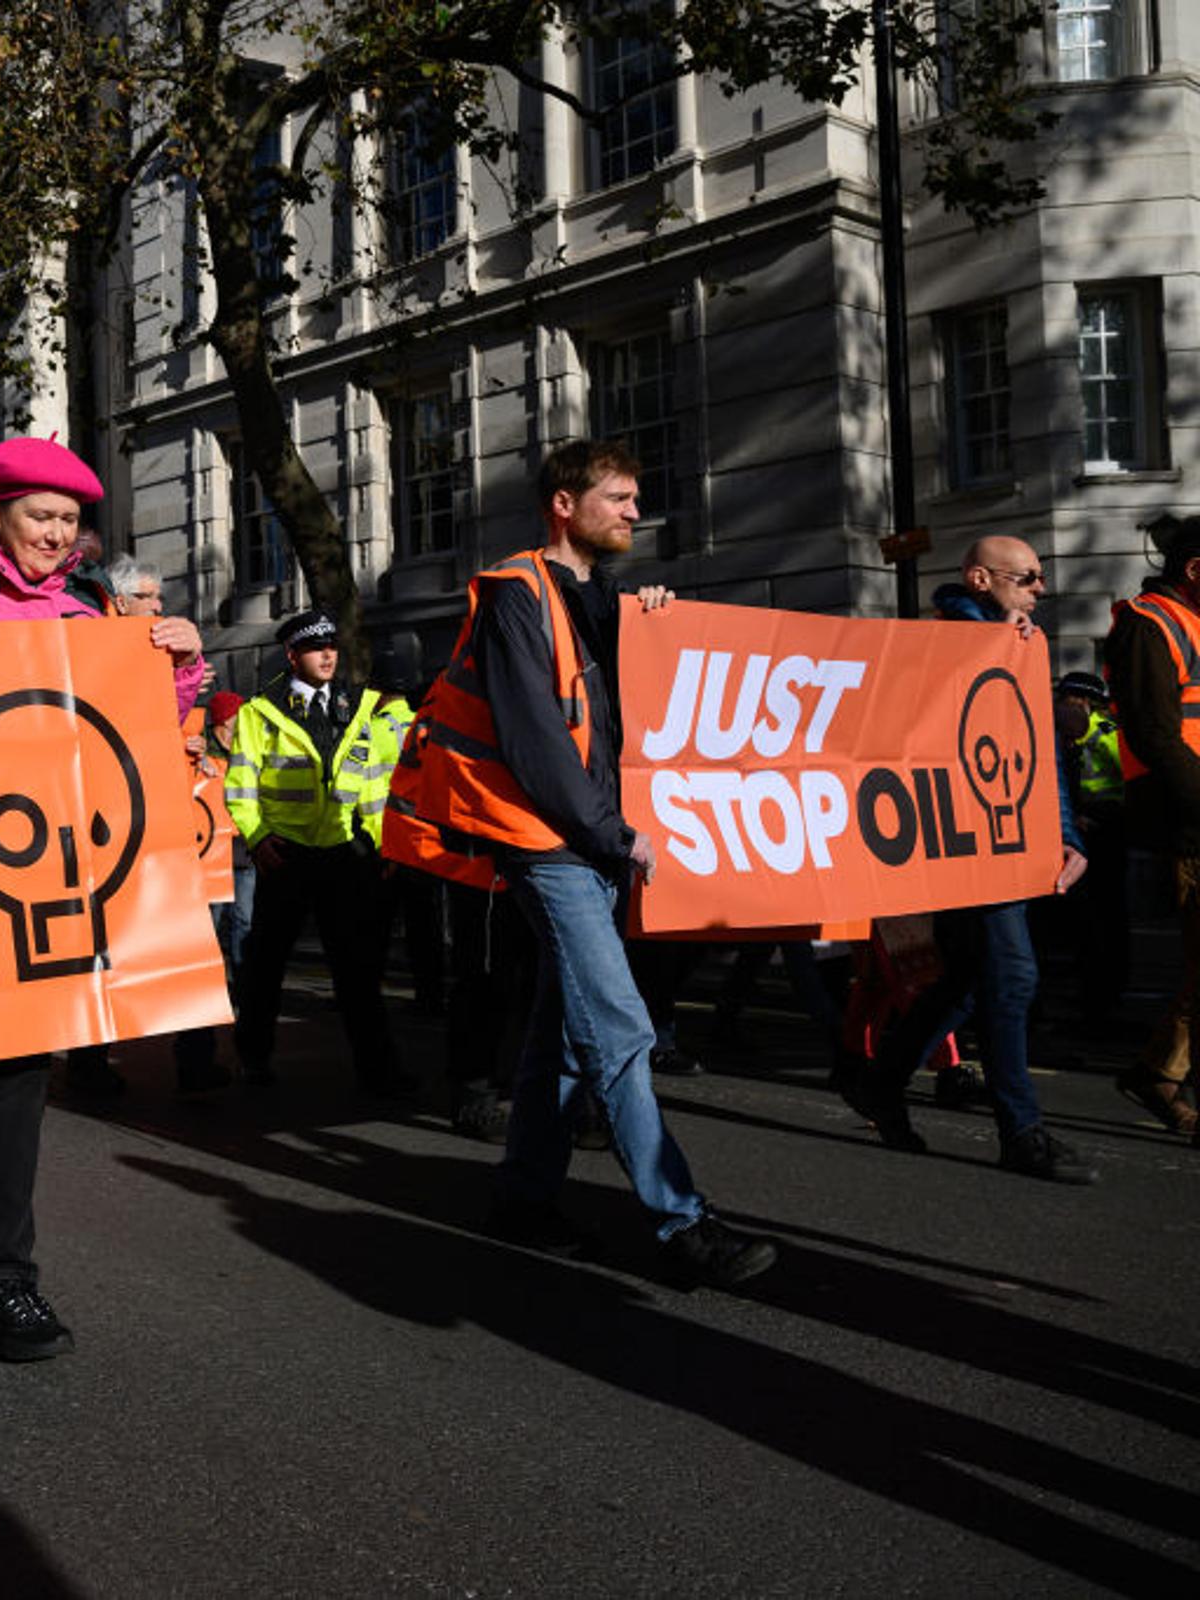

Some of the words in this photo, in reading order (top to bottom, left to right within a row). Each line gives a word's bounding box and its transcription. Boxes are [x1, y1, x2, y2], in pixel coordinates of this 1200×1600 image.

[642, 648, 867, 761] JUST
[650, 769, 850, 876] STOP
[856, 767, 978, 867] OIL
